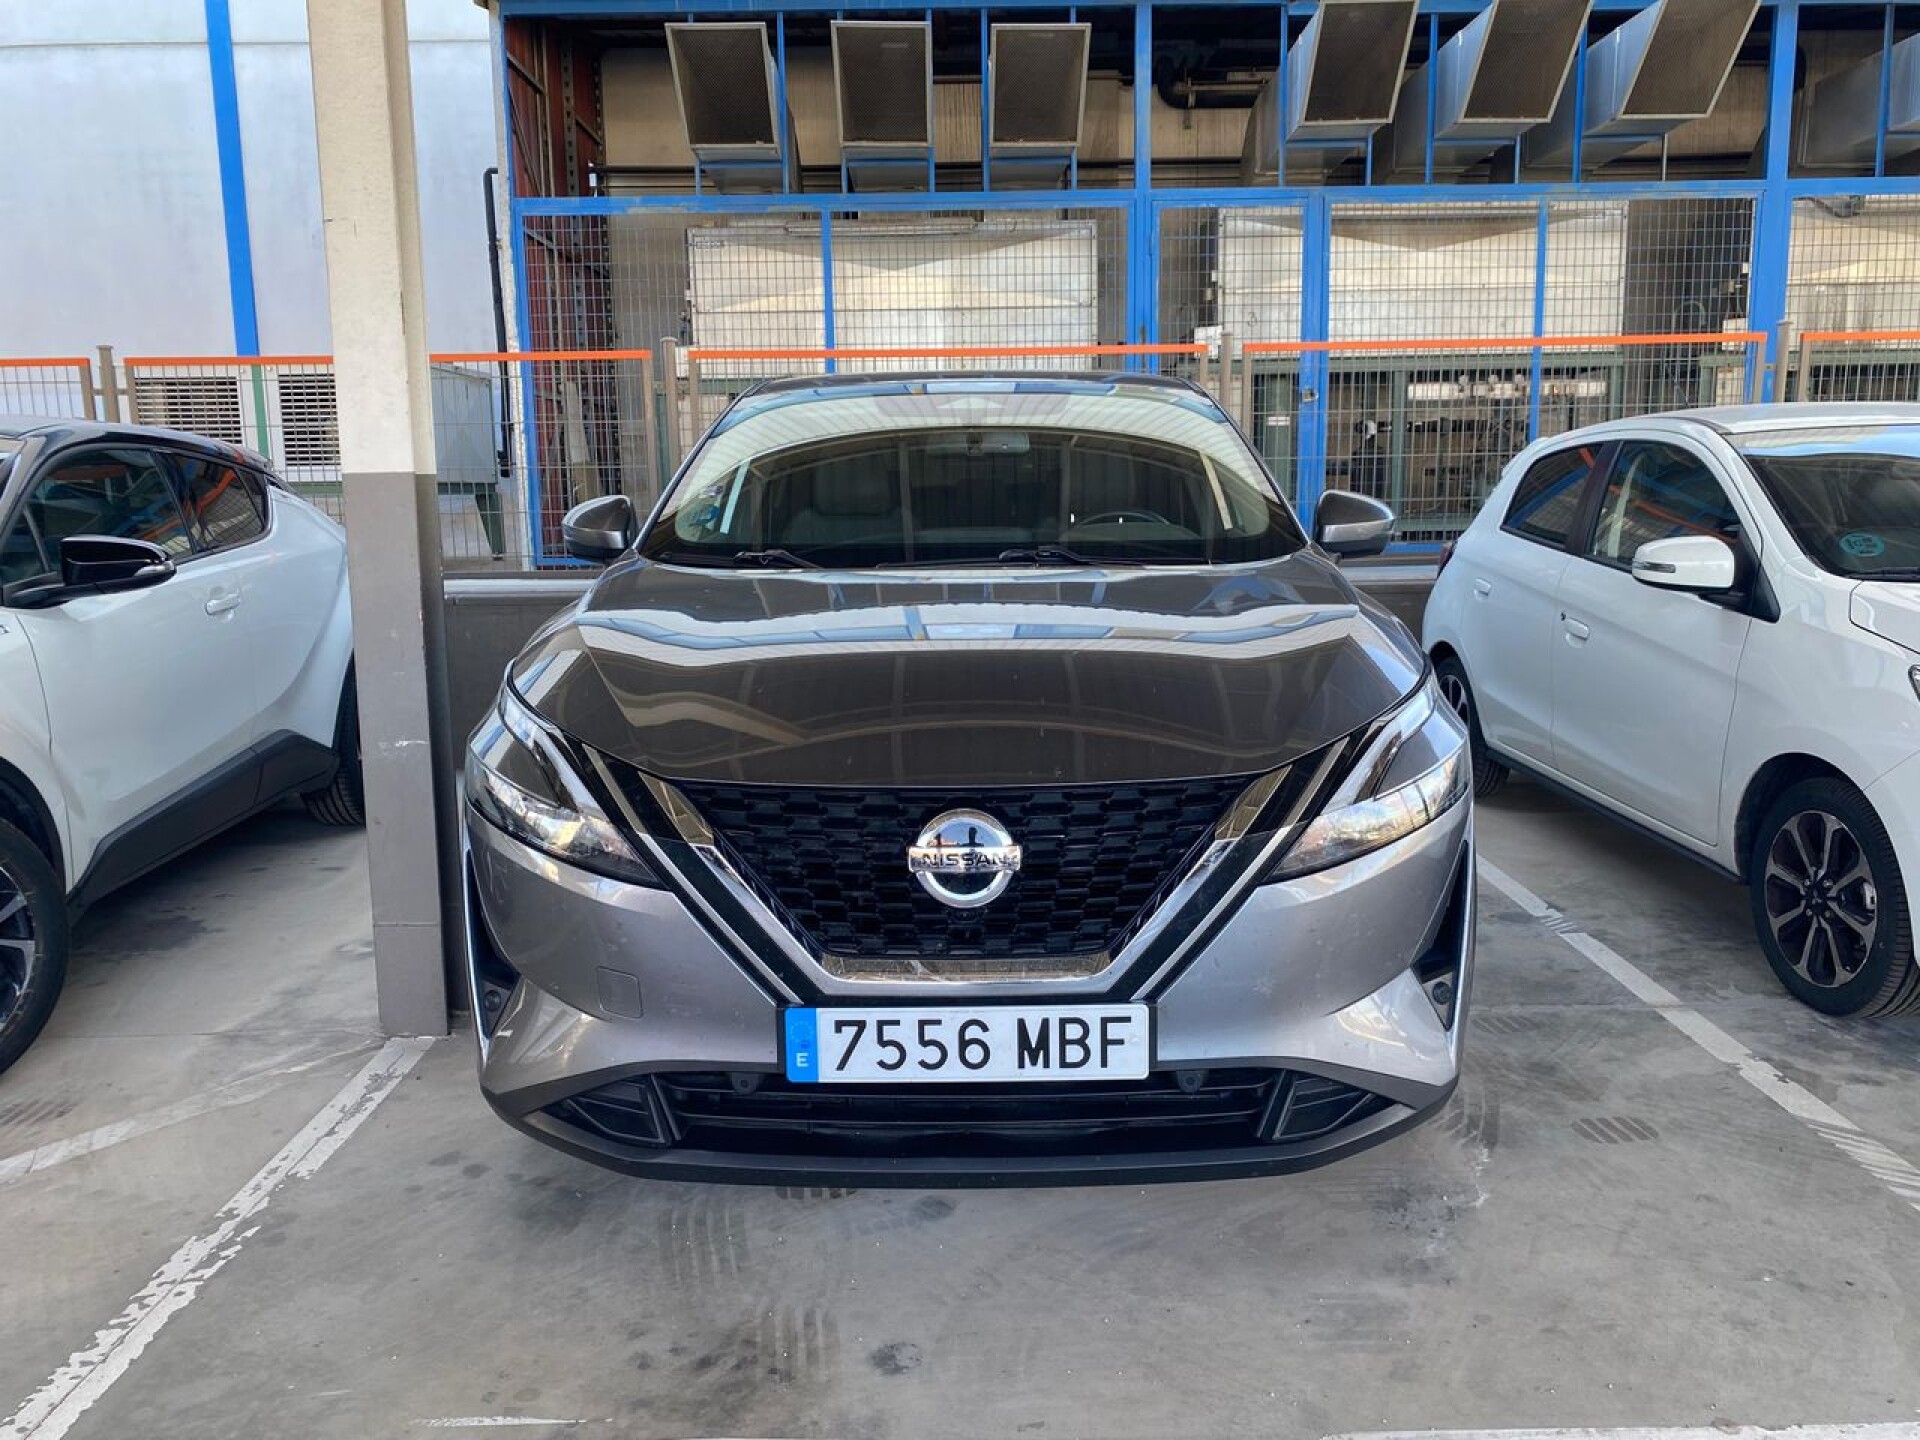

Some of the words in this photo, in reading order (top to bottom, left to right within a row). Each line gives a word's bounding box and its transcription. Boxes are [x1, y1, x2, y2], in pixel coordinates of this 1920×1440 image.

[920, 852, 1008, 868] NISSAN
[833, 1017, 991, 1071] 7556
[1016, 1016, 1132, 1069] MBF
[795, 1052, 809, 1068] E
